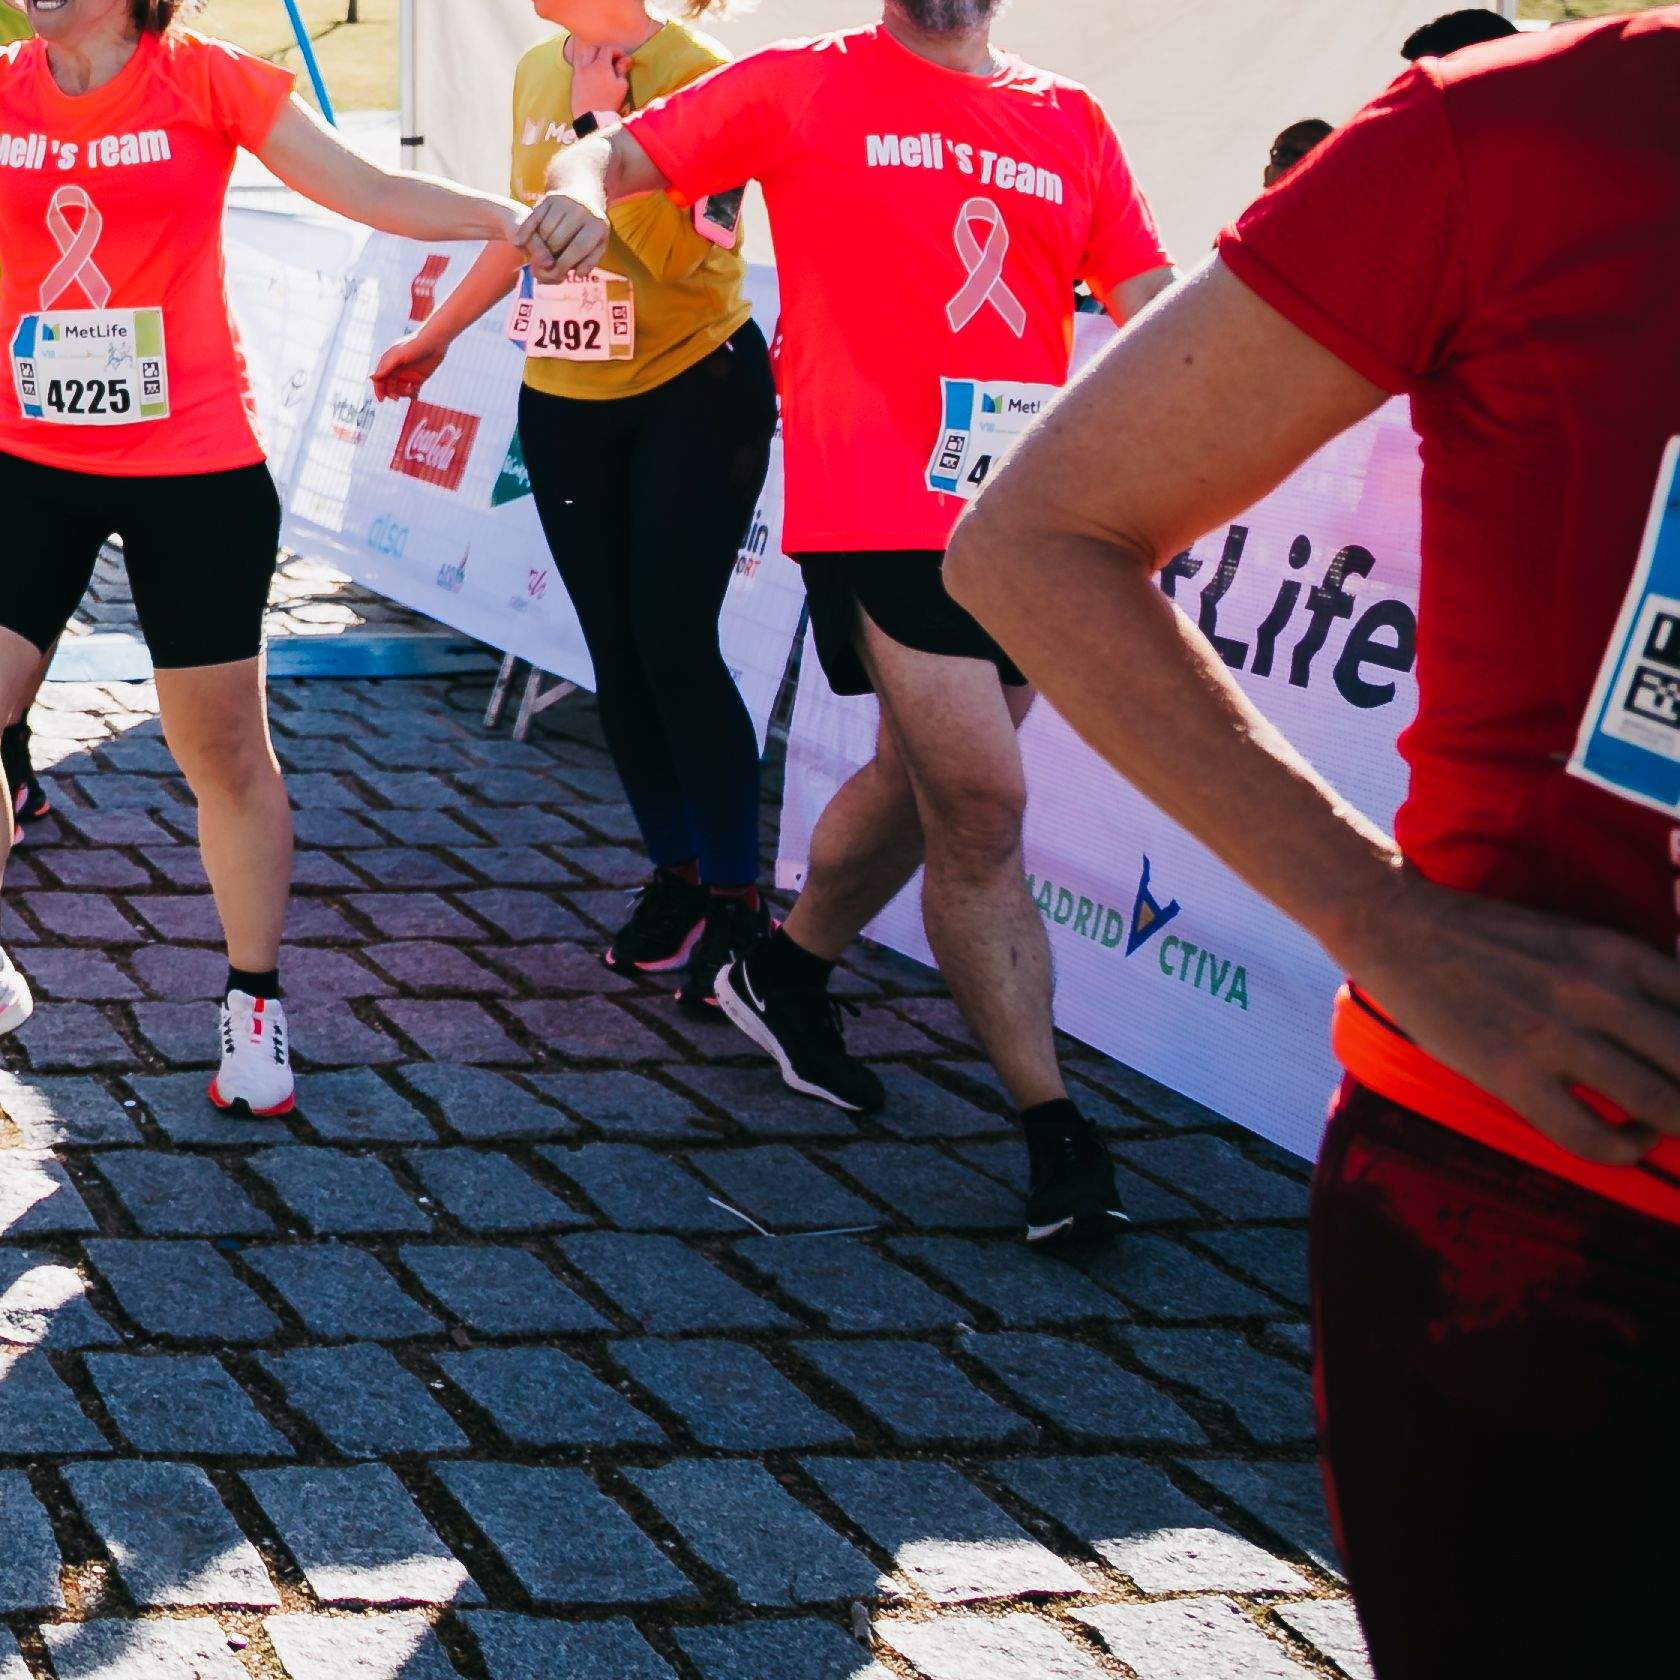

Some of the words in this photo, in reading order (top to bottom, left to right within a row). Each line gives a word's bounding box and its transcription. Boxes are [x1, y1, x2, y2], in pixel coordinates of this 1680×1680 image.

[979, 149, 1064, 206] Team
[65, 323, 128, 339] MetLife
[534, 319, 602, 352] 2492
[46, 378, 131, 415] 4225
